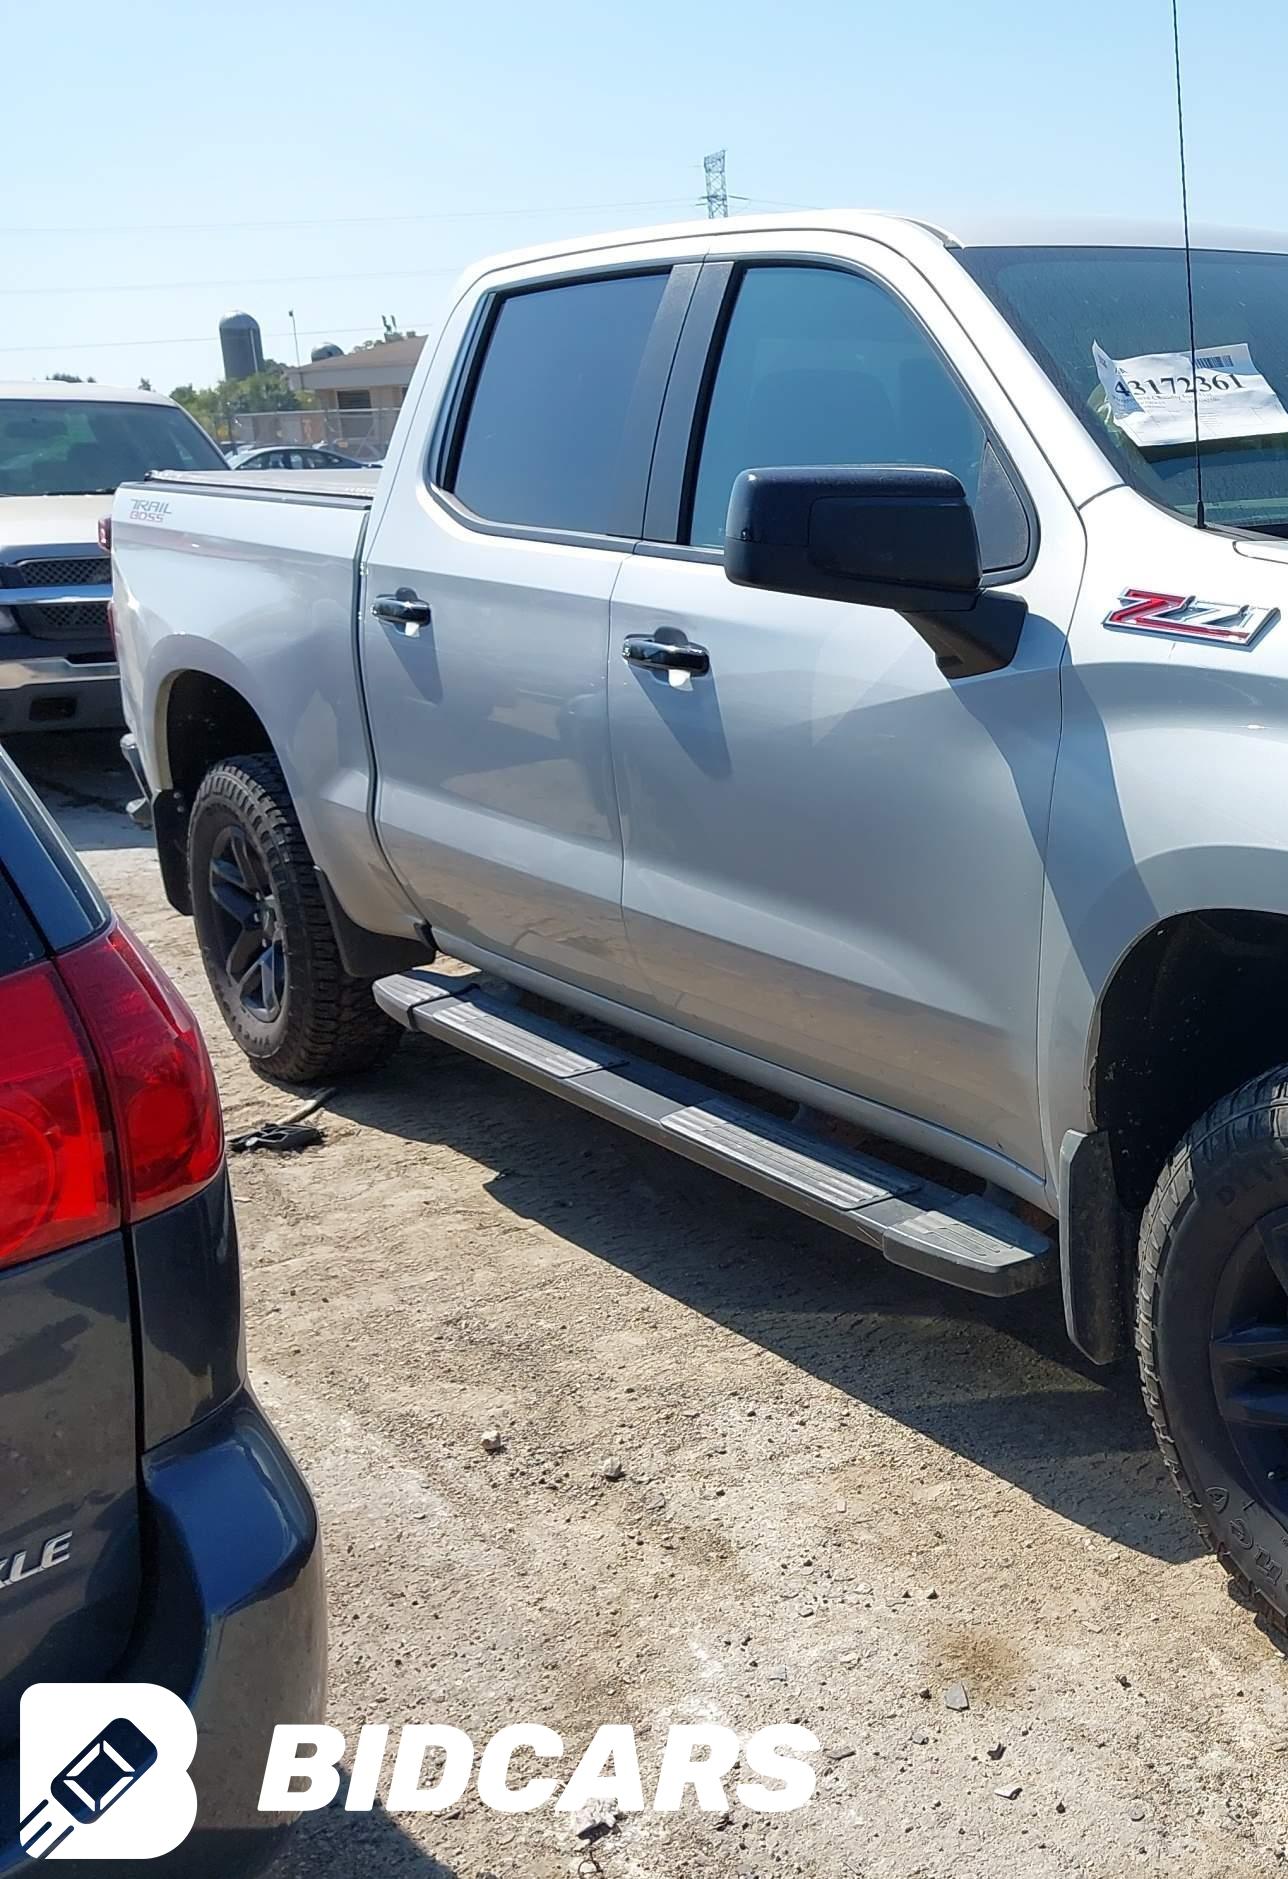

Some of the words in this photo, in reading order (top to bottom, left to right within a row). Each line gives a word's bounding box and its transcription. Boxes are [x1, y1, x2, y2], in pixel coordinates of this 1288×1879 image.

[1114, 372, 1247, 397] 43172361
[130, 498, 173, 514] TRAIL
[129, 510, 164, 523] BOSS
[1101, 588, 1281, 653] Z71
